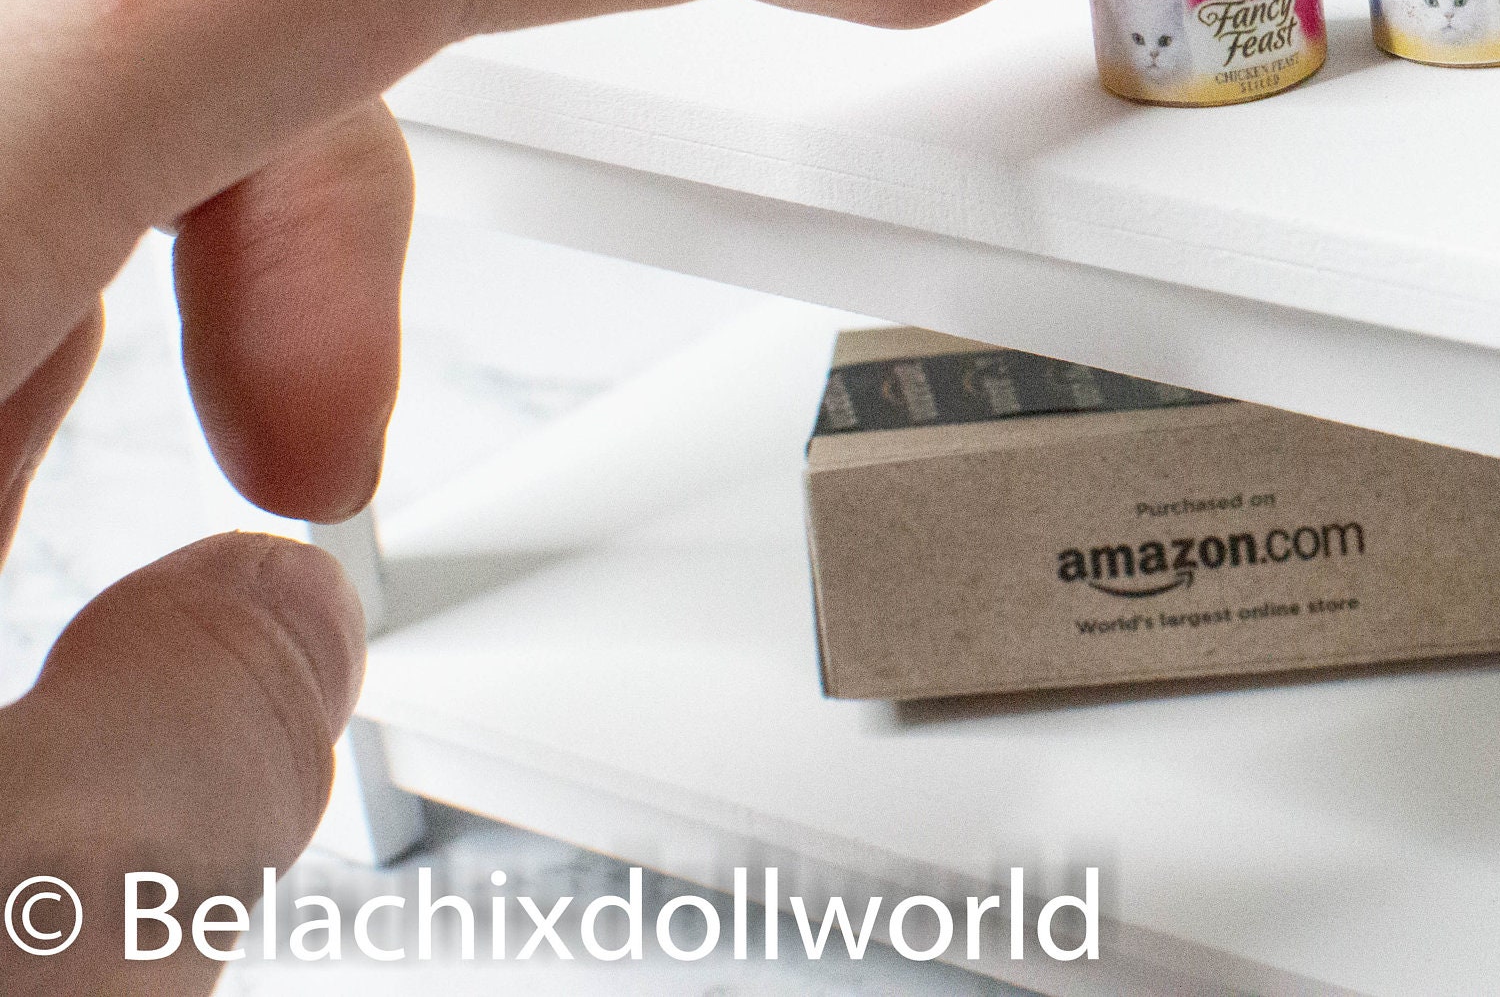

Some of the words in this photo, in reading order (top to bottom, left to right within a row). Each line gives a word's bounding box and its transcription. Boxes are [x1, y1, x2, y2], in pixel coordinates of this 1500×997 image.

[1217, 15, 1298, 68] Feast
[1215, 65, 1269, 85] CHICKEN
[1271, 51, 1300, 73] FEAST
[1135, 493, 1243, 518] Purchased
[1249, 492, 1276, 508] on
[1057, 521, 1366, 583] amazon.com
[1075, 614, 1153, 635] World's
[1160, 609, 1231, 629] largest
[1237, 602, 1301, 621] online
[1307, 596, 1360, 614] store
